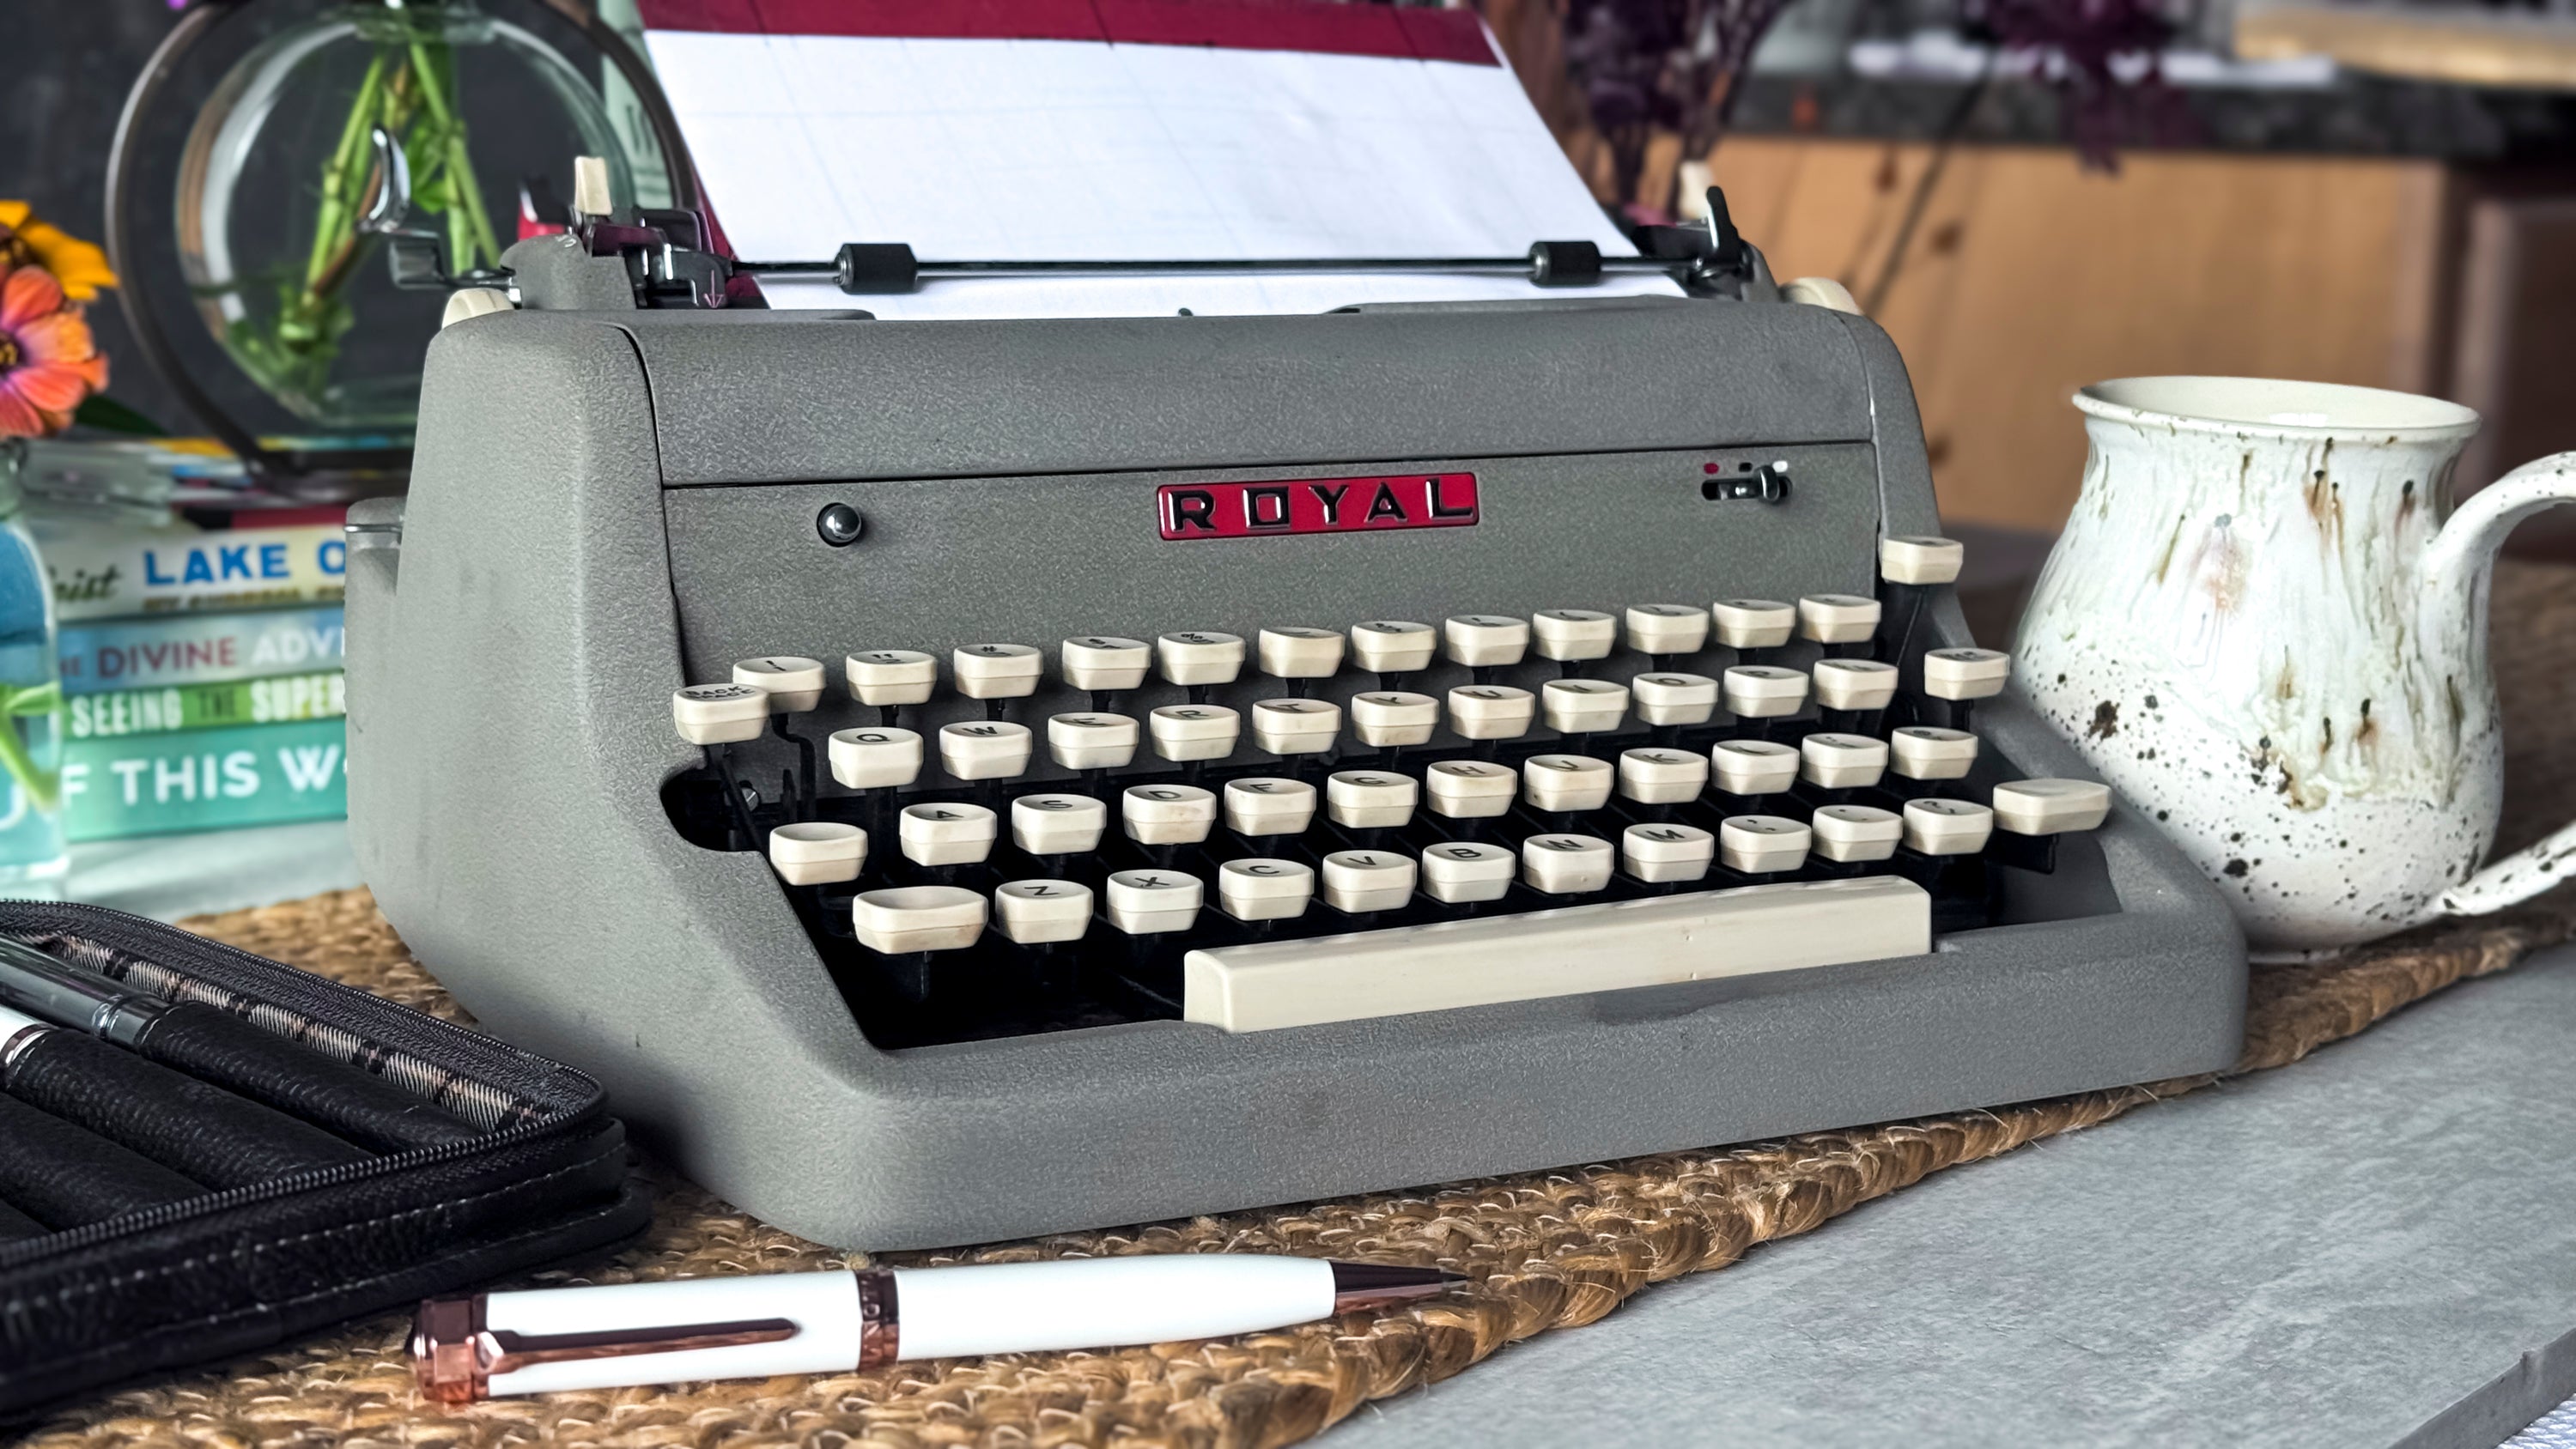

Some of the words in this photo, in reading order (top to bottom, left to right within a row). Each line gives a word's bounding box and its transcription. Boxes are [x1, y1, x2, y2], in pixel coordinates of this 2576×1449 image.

[1167, 478, 1474, 533] ROYAL
[143, 542, 290, 586] LAKE
[317, 540, 346, 575] O
[96, 635, 239, 679] DIVINE
[250, 627, 345, 665] ADV
[70, 688, 184, 738] SEEING
[685, 685, 742, 695] BACK
[110, 750, 261, 806] THIS
[277, 743, 347, 792] W
[1024, 885, 1060, 896] Z
[1134, 876, 1170, 888] X
[1249, 865, 1280, 875] C
[1347, 855, 1378, 866] V
[1449, 848, 1483, 858] B
[1546, 839, 1583, 849] N
[1645, 828, 1685, 840] M
